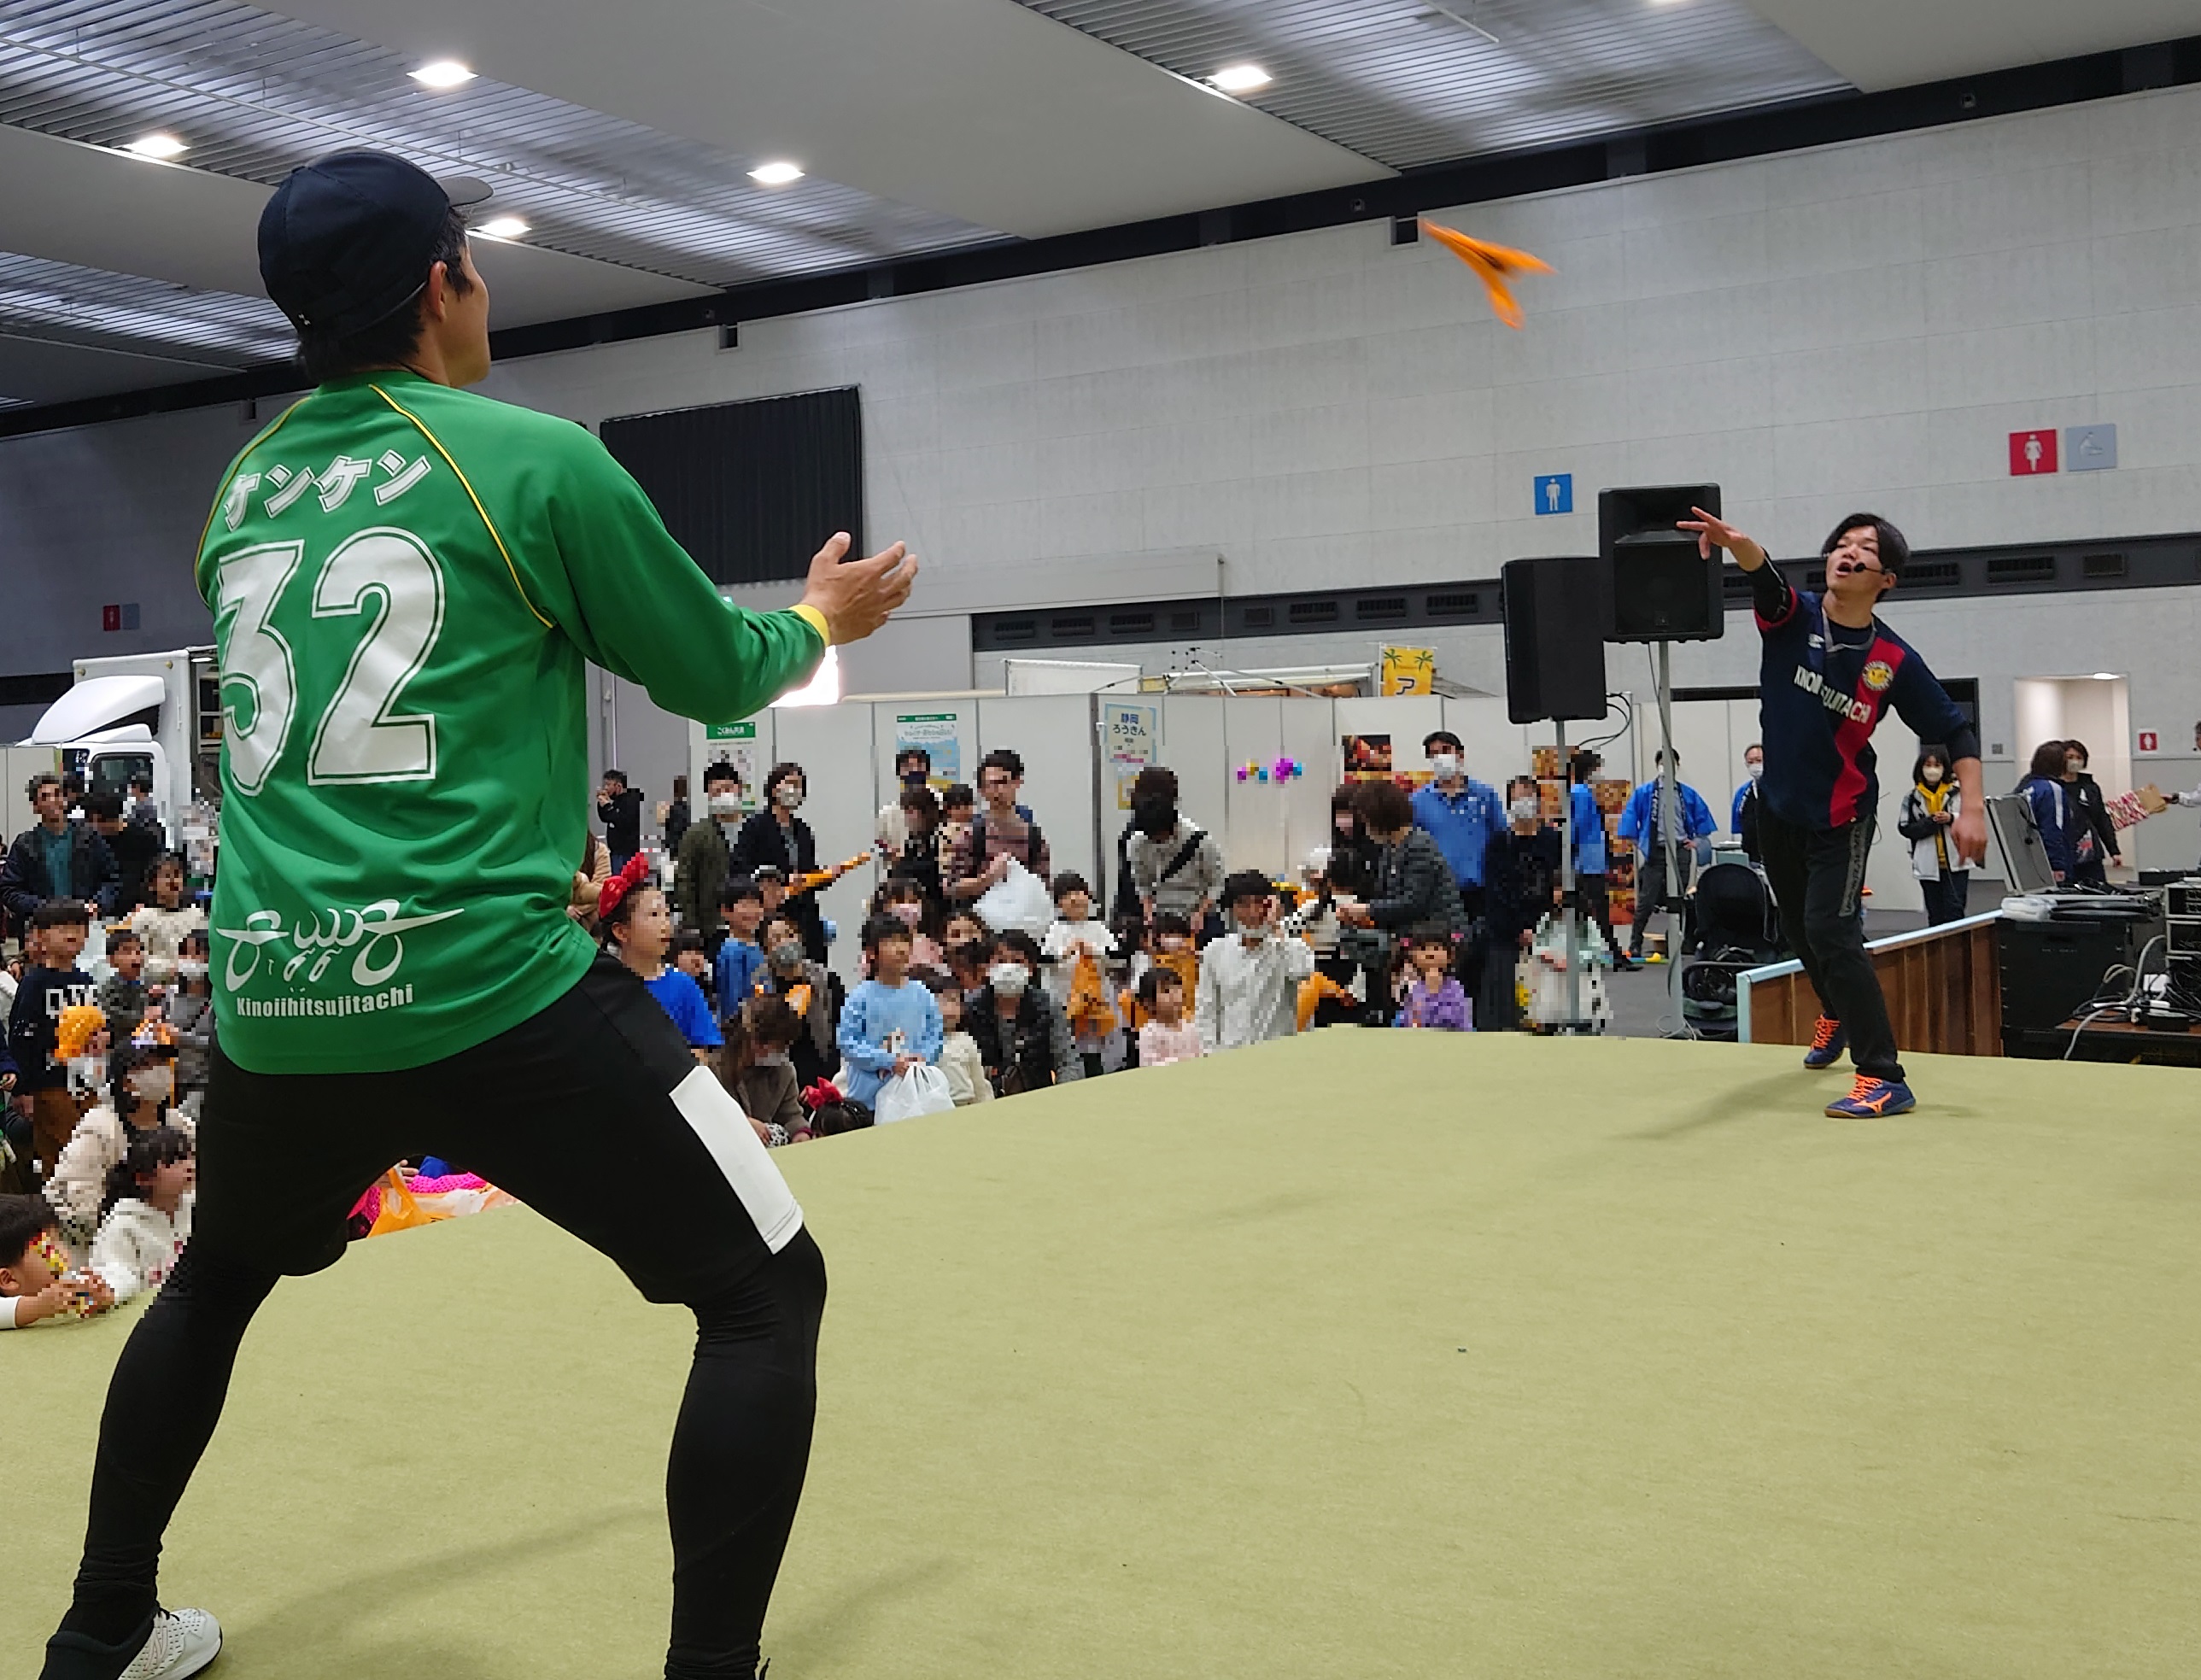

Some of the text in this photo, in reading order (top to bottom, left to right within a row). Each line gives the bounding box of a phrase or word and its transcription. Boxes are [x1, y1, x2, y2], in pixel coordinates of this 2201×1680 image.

[224, 449, 431, 532] ケンケン
[217, 525, 446, 796] 32
[1112, 723, 1147, 736] ろうきん
[236, 983, 413, 1017] Kinoiihitsujitachi
